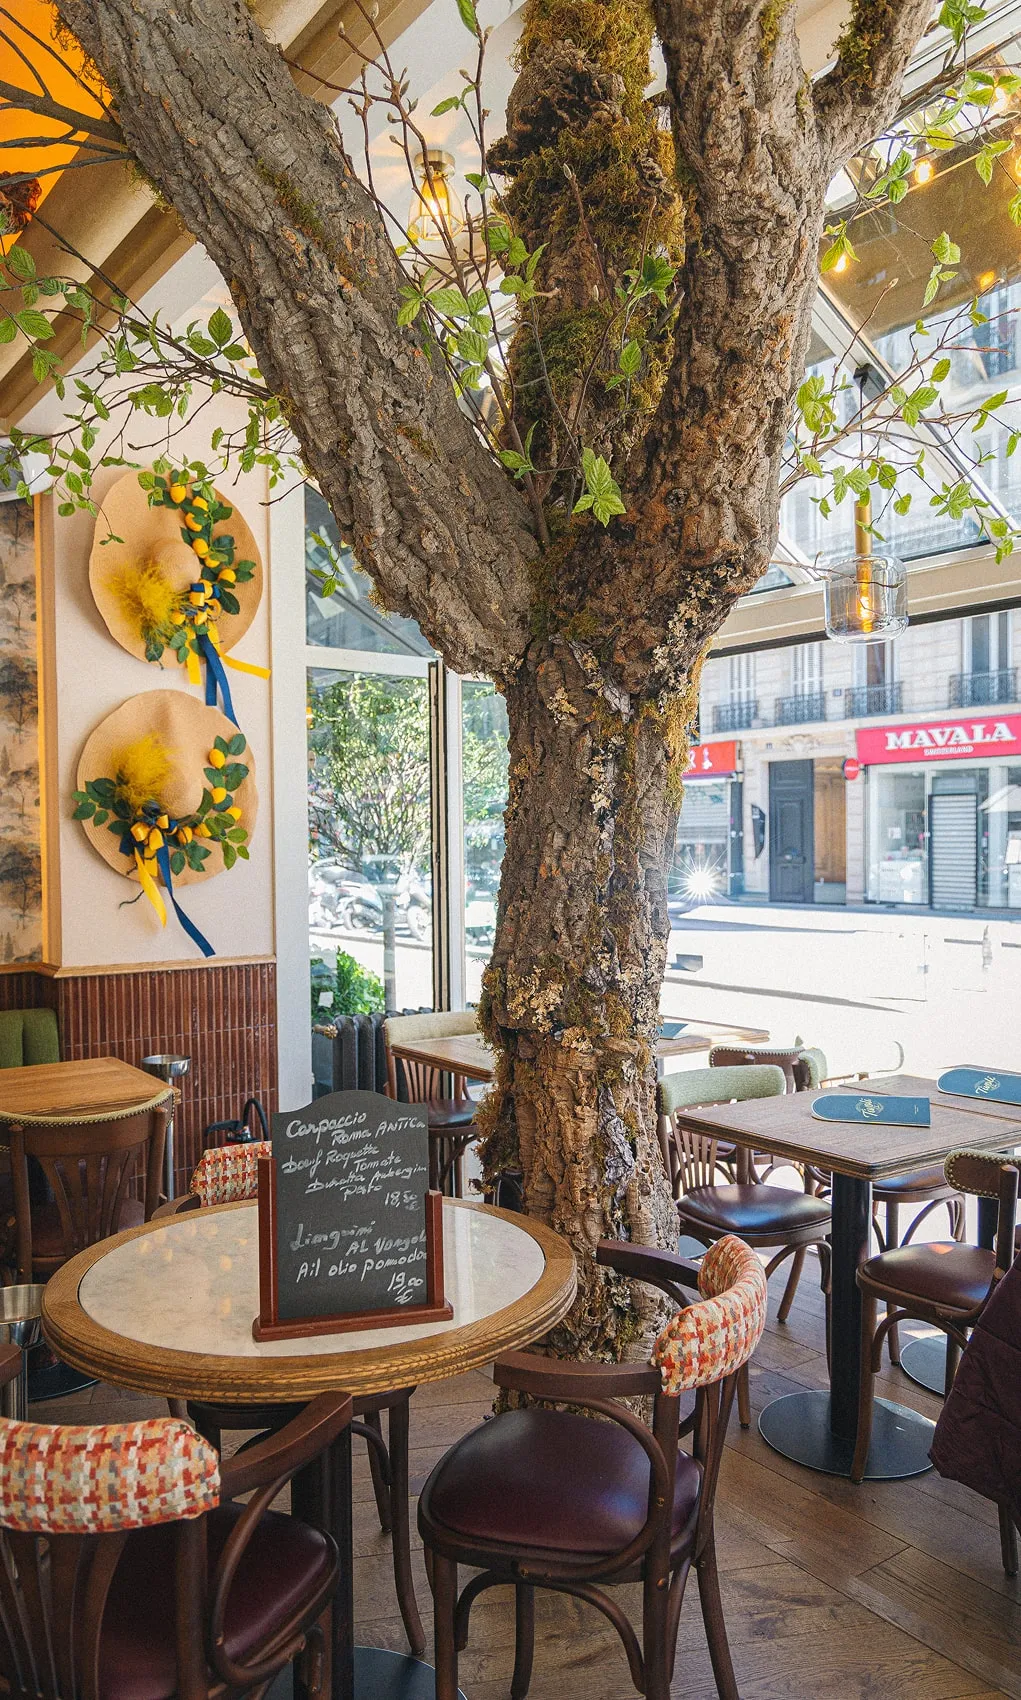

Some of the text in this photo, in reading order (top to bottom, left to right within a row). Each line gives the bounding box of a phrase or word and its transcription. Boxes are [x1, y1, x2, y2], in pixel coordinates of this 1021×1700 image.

[884, 722, 1017, 750] MAVALA
[286, 1111, 367, 1145] Carpaccio
[331, 1129, 372, 1147] Roma
